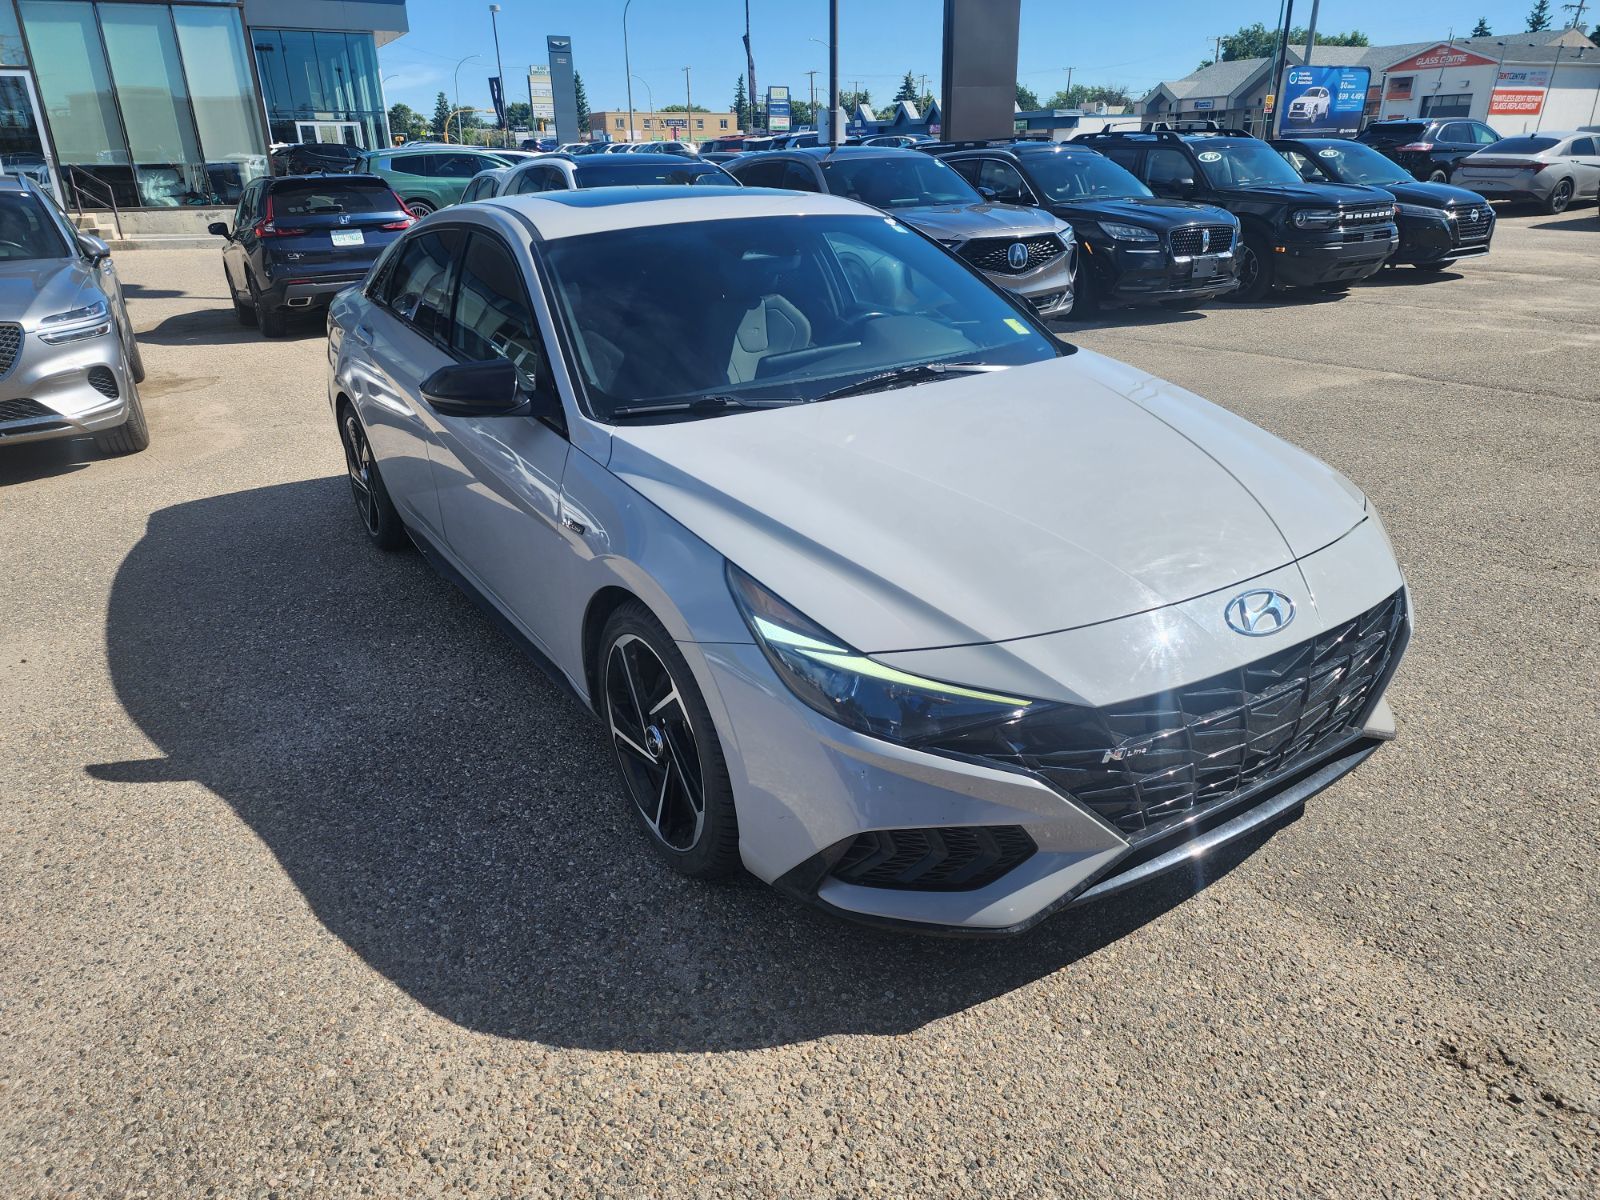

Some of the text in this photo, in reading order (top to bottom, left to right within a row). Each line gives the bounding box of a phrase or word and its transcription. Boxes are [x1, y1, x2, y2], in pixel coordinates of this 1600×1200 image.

[1416, 57, 1439, 65] GLASS
[1345, 210, 1391, 220] BRONCO
[1127, 747, 1147, 757] Line
